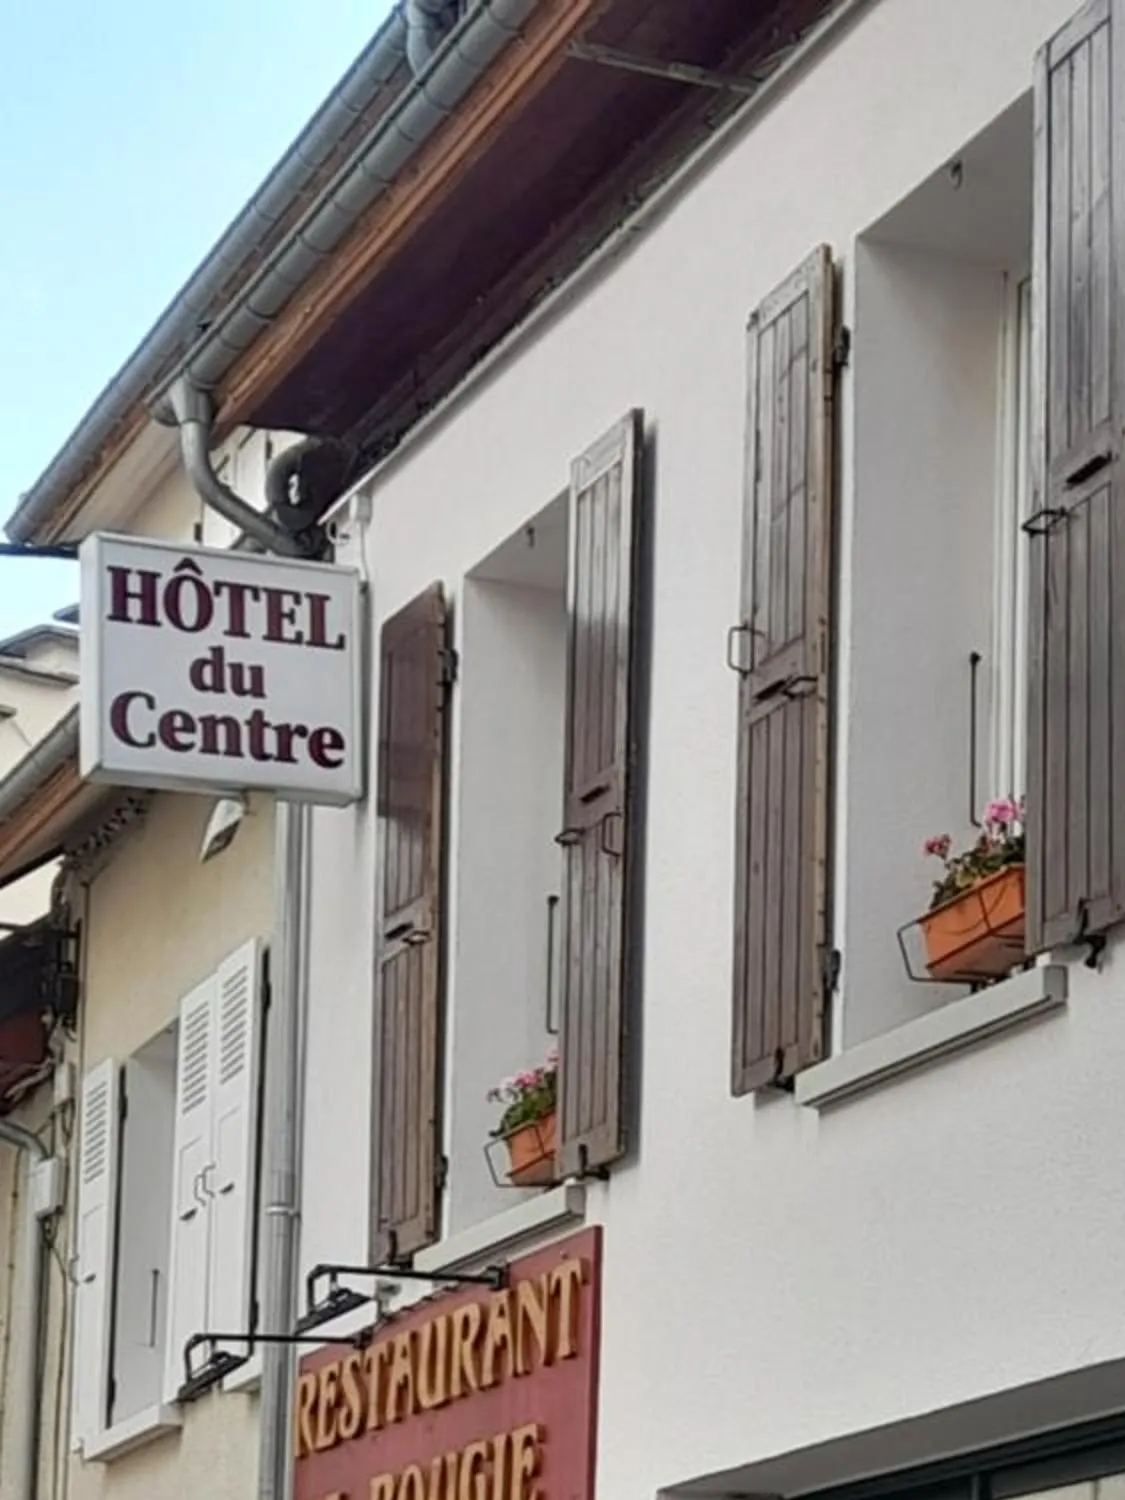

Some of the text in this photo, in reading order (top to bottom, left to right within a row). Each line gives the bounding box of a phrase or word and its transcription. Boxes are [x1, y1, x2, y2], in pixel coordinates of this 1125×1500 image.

[106, 557, 346, 650] HÔTEL
[189, 646, 266, 698] du
[109, 691, 345, 768] Centre
[294, 1258, 588, 1458] RESTAURANT
